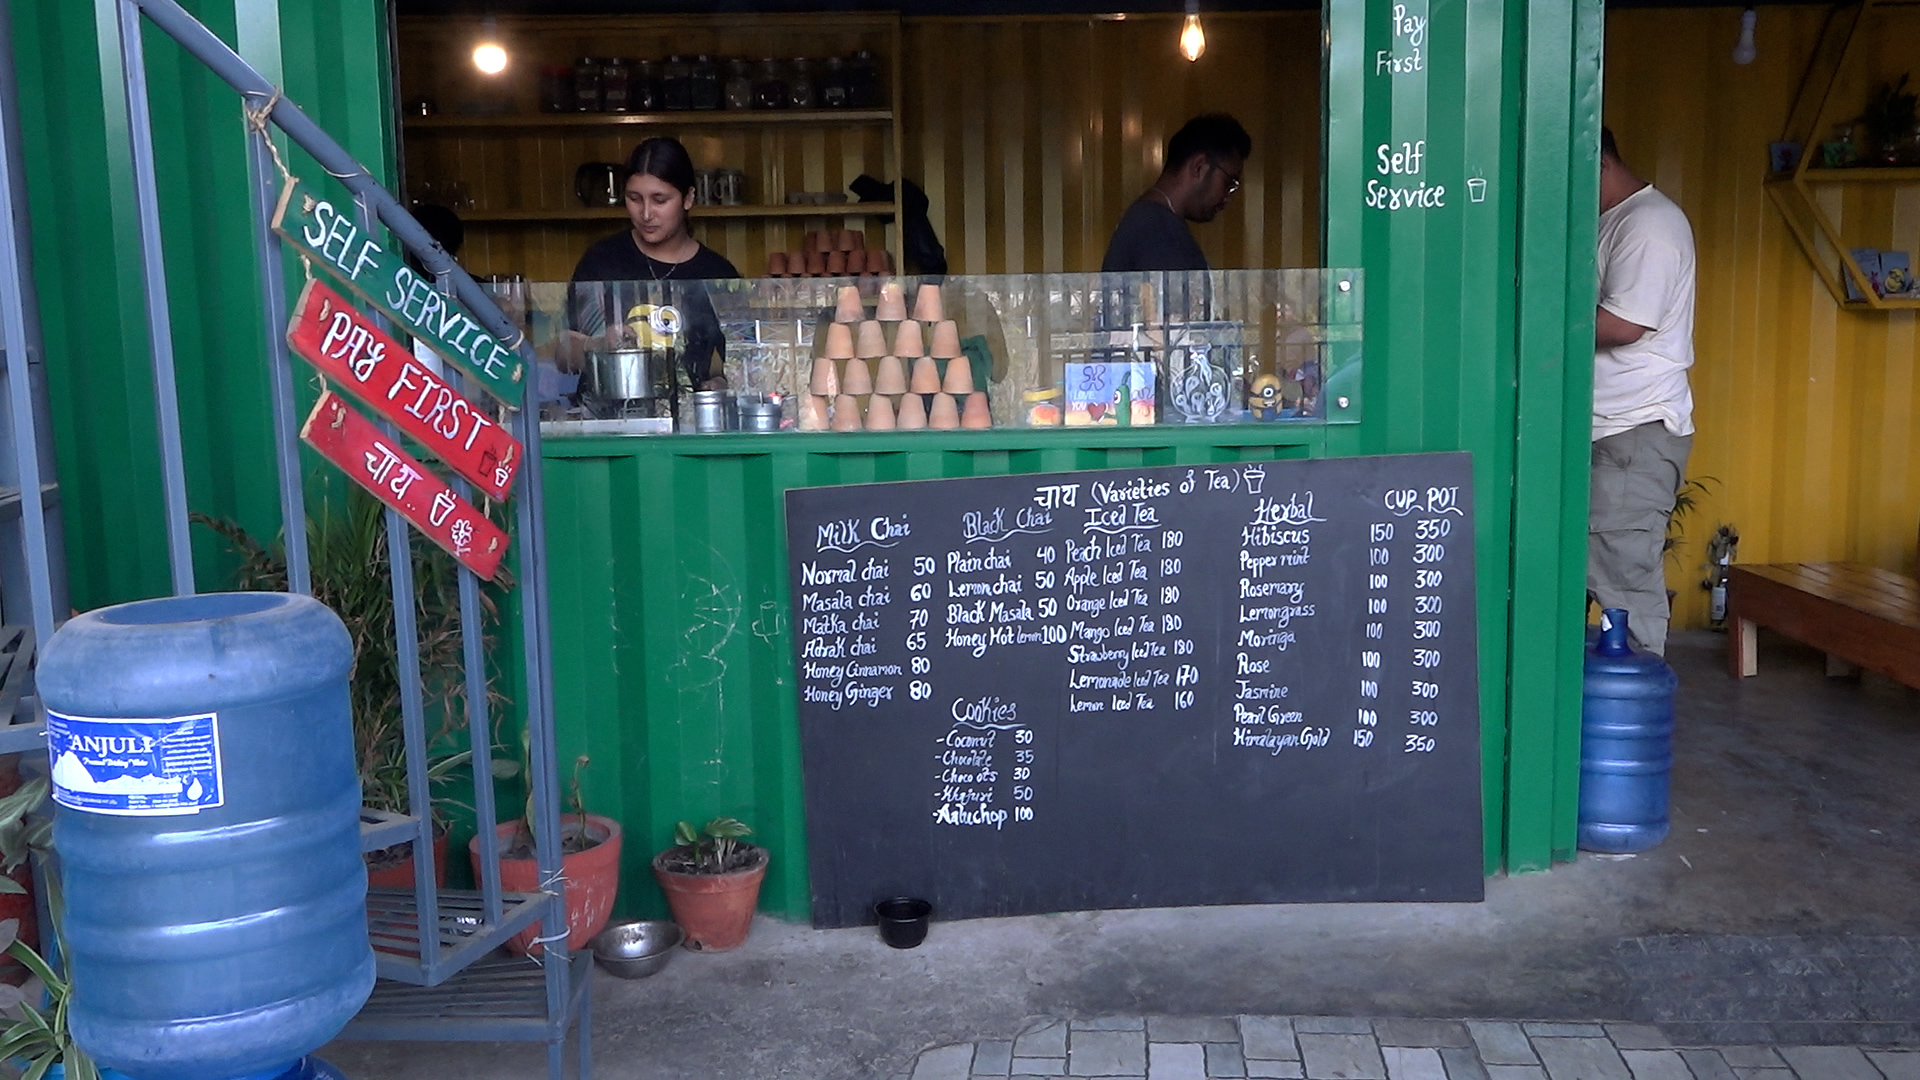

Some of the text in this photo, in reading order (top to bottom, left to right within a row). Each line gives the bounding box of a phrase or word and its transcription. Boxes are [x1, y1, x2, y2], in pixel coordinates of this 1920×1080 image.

[1393, 4, 1426, 47] Pay
[1376, 48, 1423, 76] First
[1377, 141, 1425, 174] Self
[1366, 179, 1445, 210] Service
[303, 201, 509, 379] SELF SERVICE
[388, 362, 492, 450] FIRST
[1072, 401, 1086, 411] YOU
[1179, 469, 1196, 493] of
[1034, 484, 1080, 509] चाय
[1254, 490, 1314, 523] Herbal
[1385, 487, 1459, 512] CUP POT
[870, 514, 911, 540] Chai
[1016, 507, 1053, 529] Chai
[1084, 502, 1159, 527] Iced Tea
[1241, 519, 1450, 546] Hibiscus 150 350
[1065, 531, 1184, 563] Peach Iced Tea 180
[1370, 548, 1389, 566] 100
[1413, 544, 1444, 563] 300
[801, 557, 936, 586] Normal chai 50
[947, 547, 1055, 574] Plain chai 40
[1035, 571, 1055, 589] 50
[1064, 558, 1182, 595] Apple Iced Tea 180
[1240, 570, 1443, 603] Rosemary 100 300
[802, 584, 931, 612] Masala chai 60
[989, 600, 1034, 623] Masala
[1038, 598, 1057, 618] 50
[1066, 586, 1180, 618] Orange Iced Tea 180
[852, 612, 880, 630] chai
[909, 609, 929, 630] 70
[1240, 597, 1442, 628] Lemongrass 100 300
[945, 629, 987, 658] Honey
[989, 627, 1014, 646] Hot
[1041, 626, 1067, 645] 100
[1069, 615, 1182, 644] Mango Iced Tea 180
[1237, 621, 1441, 651] Moringa 100 300
[850, 635, 877, 655] chai
[906, 632, 927, 650] 65
[1067, 639, 1194, 670] Strawberry Iced Tea 180
[803, 657, 930, 687] Honey Cinnamon 80
[1237, 649, 1440, 675] Rose 100 300
[1069, 669, 1132, 690] Lemonade
[1153, 671, 1169, 685] Tea
[1175, 665, 1199, 687] 170
[1235, 679, 1439, 700] Jasmine 100 300
[804, 680, 931, 711] Honey Ginger 80
[1070, 691, 1194, 712] Lemon Iced Tea 160
[1268, 705, 1303, 723] Green
[1358, 709, 1378, 726] 100
[1410, 711, 1438, 726] 300
[1015, 730, 1033, 744] 30
[1353, 730, 1374, 747] 150
[1404, 735, 1436, 752] 350
[1015, 750, 1034, 764] 35
[1013, 767, 1030, 780] 30
[1014, 786, 1033, 800] 50
[1015, 807, 1033, 821] 100
